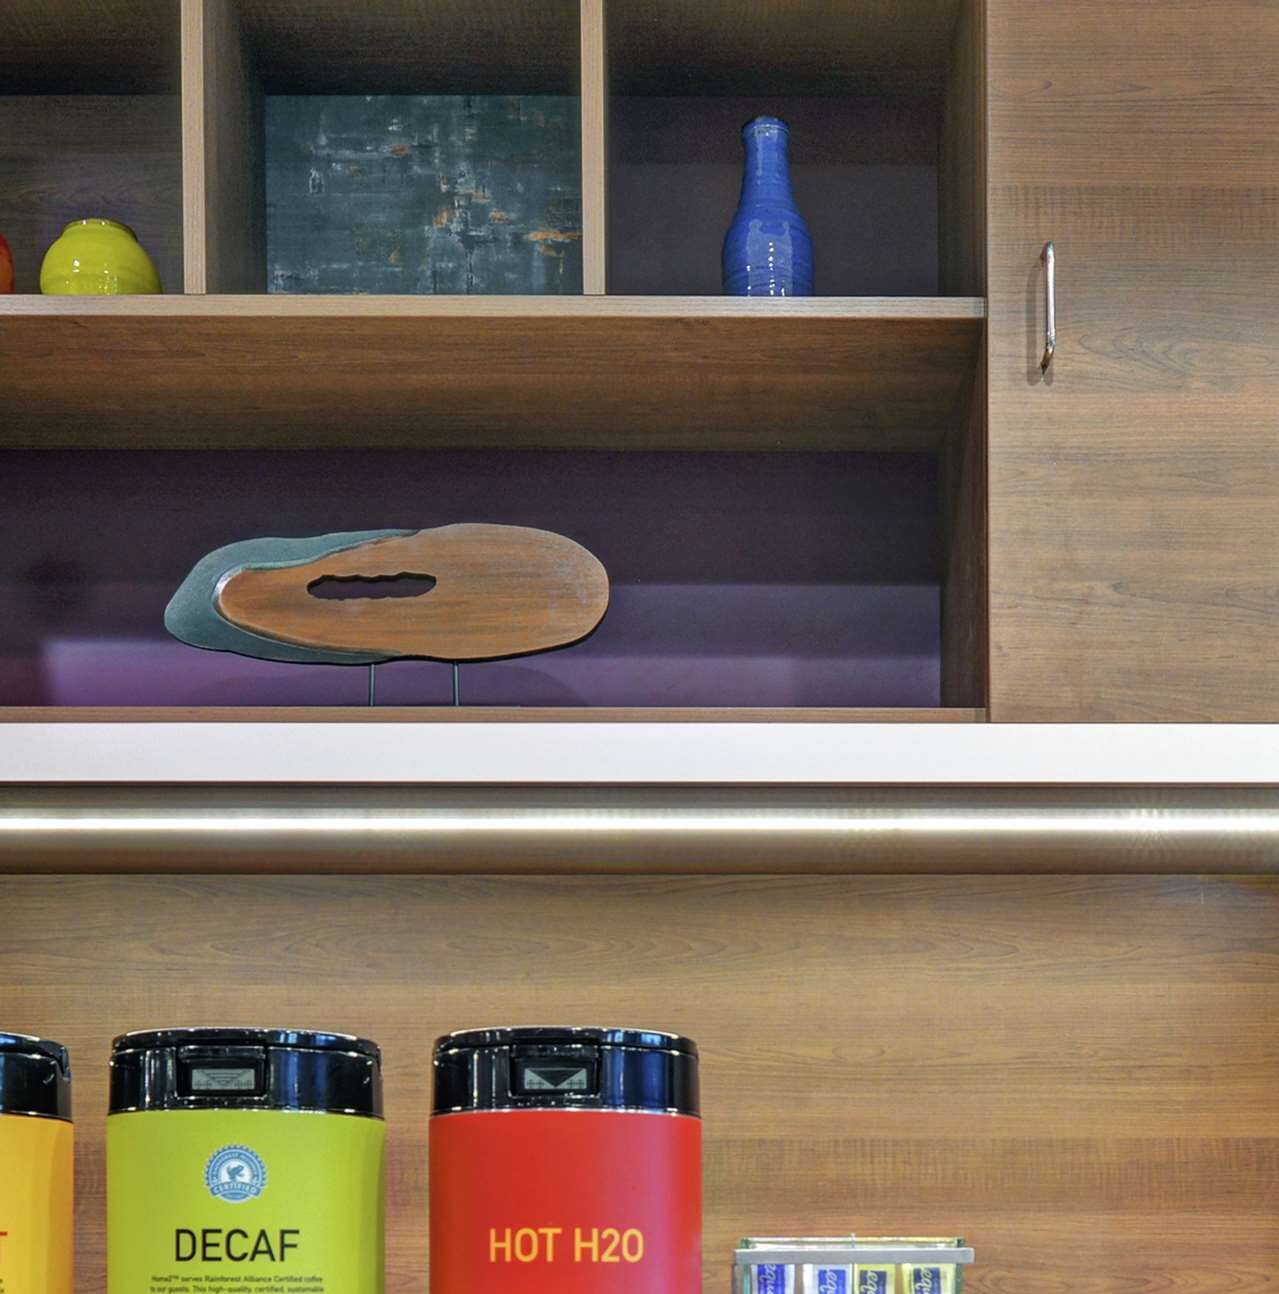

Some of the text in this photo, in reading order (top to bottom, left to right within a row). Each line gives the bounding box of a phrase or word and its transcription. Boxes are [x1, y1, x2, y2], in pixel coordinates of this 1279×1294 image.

[175, 1229, 299, 1262] DECAF
[489, 1228, 562, 1262] HOT
[181, 1275, 203, 1283] serves
[204, 1275, 241, 1283] Rainforest
[243, 1275, 272, 1283] Alliance
[273, 1275, 303, 1283] Certified
[304, 1275, 323, 1283] coffee
[192, 1285, 207, 1294] This
[286, 1285, 324, 1294] sustainable
